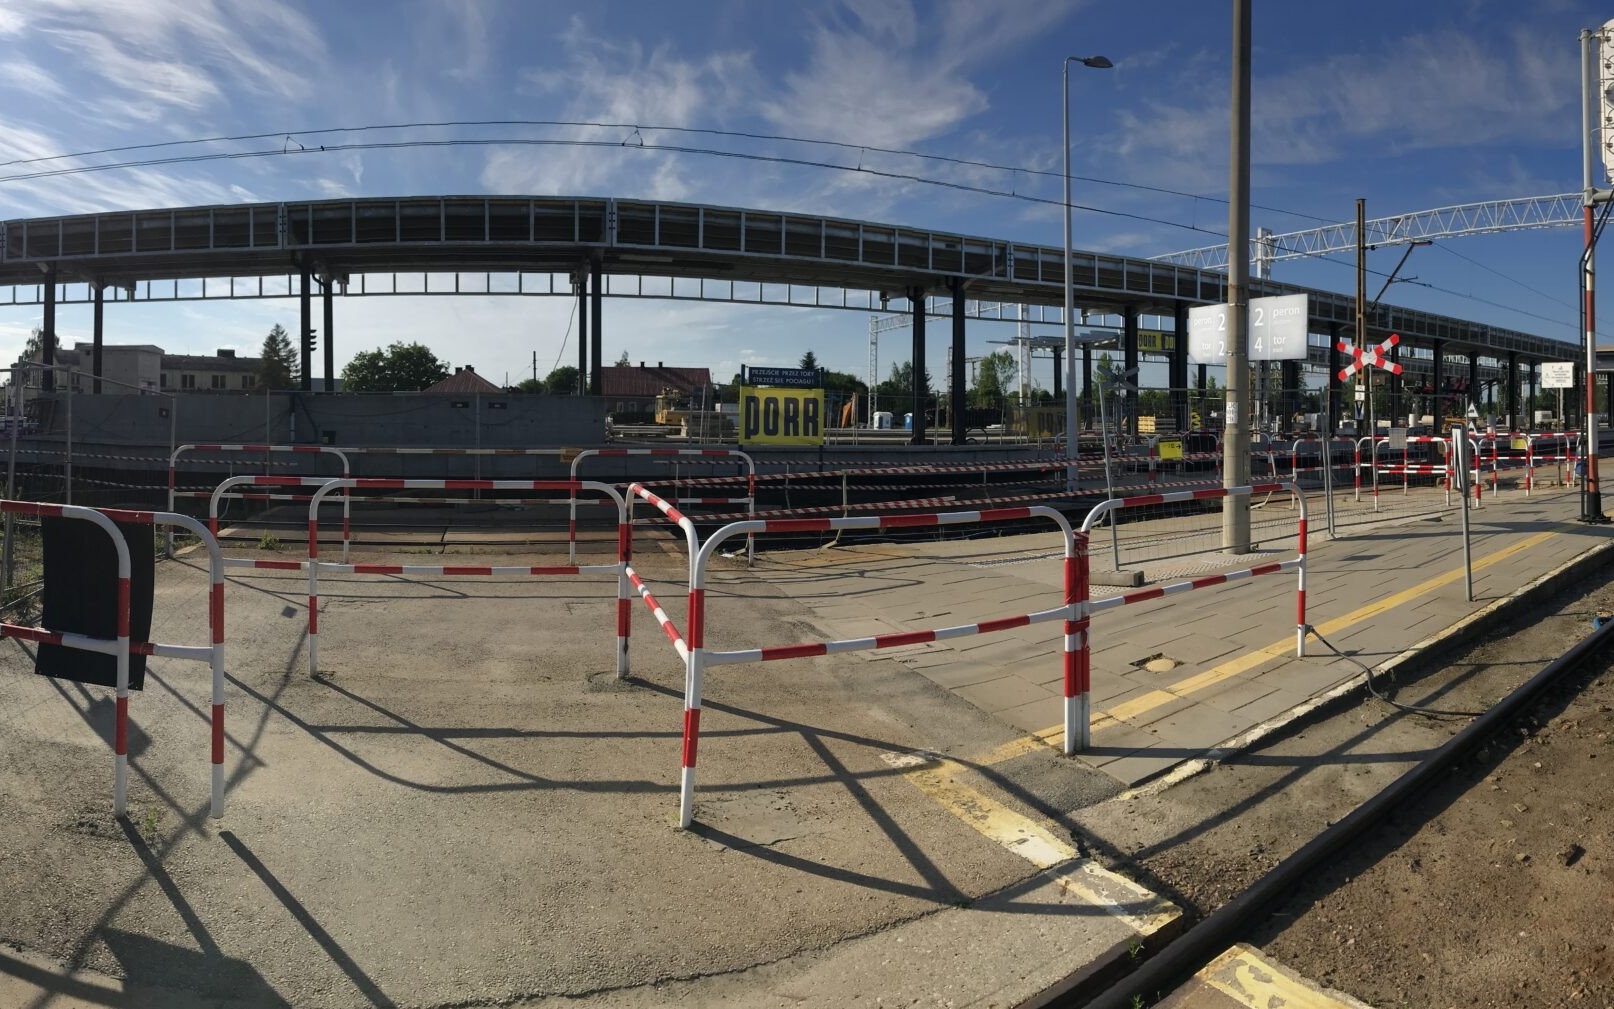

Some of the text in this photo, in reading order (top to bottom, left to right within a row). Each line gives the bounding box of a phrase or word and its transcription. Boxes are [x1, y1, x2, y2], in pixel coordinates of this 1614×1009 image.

[1218, 313, 1225, 331] 2
[1254, 307, 1300, 327] 2 peron
[1218, 340, 1225, 356] 2
[1254, 335, 1287, 353] 4 tor
[744, 395, 819, 440] PORR
